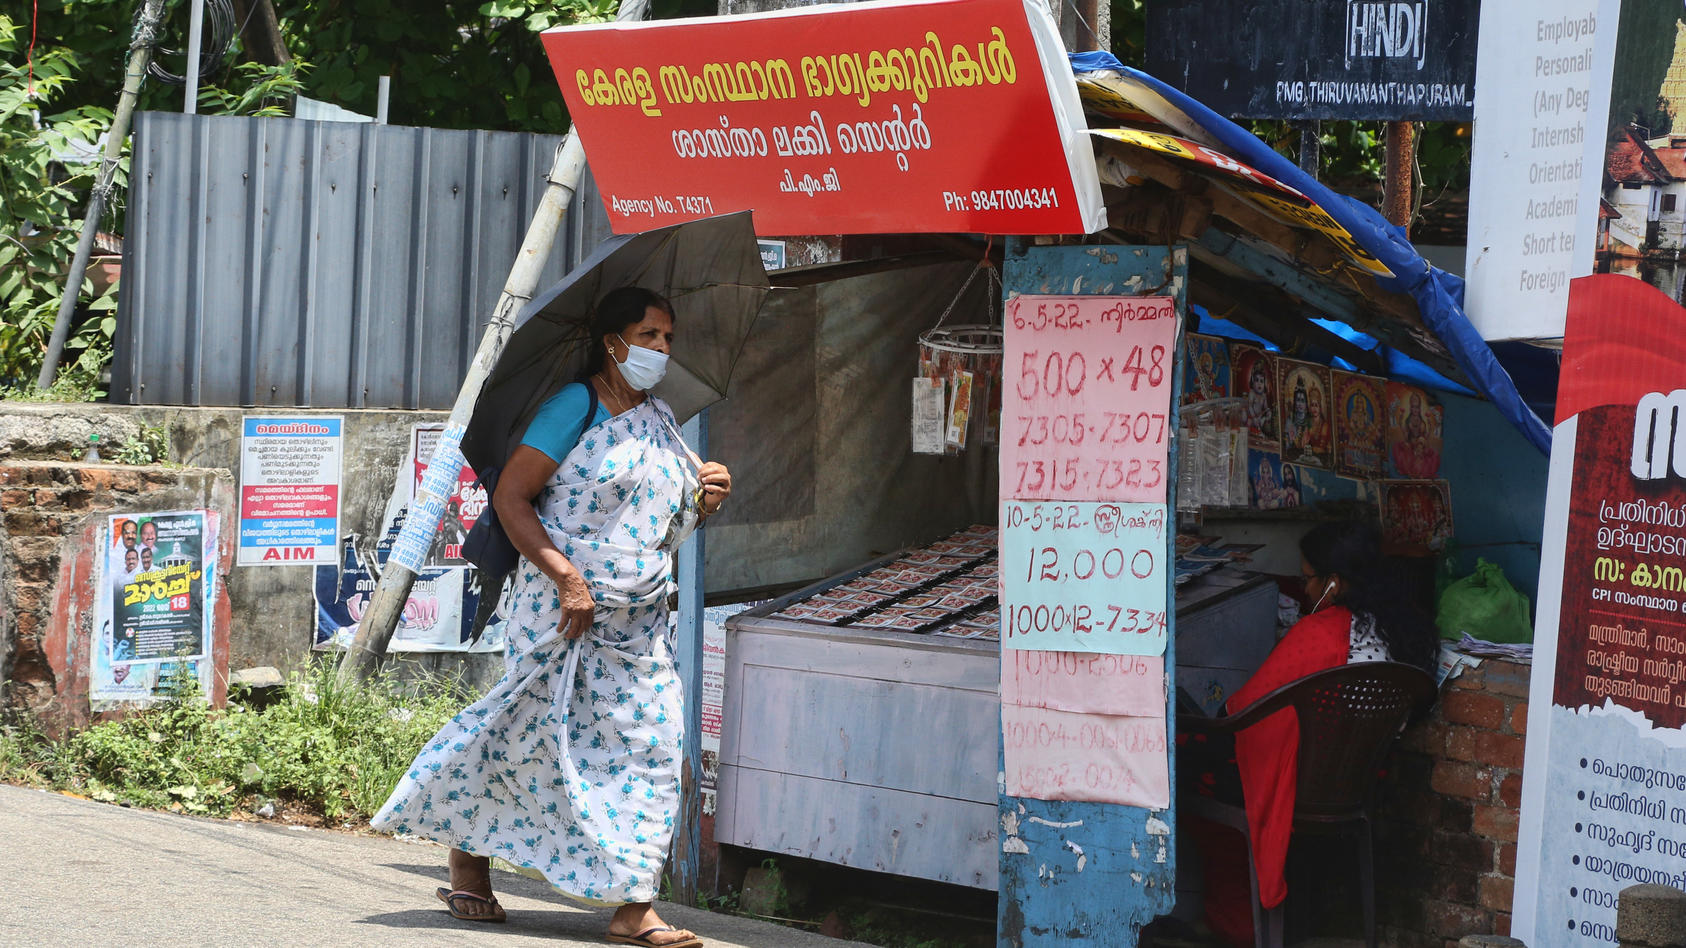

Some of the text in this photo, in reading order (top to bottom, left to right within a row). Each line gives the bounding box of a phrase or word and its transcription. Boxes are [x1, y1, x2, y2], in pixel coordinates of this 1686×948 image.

[1350, 2, 1422, 57] HINDI
[1537, 12, 1596, 45] Employab
[576, 26, 1017, 117] കേരള സംസ്ഥാന ഭാഗ്യക്കുറികൾ
[1536, 48, 1592, 77] Personali
[1534, 87, 1589, 119] (Any Deg
[671, 103, 932, 172] ശാസ്താ ലക്കി സെന്റർ
[1531, 121, 1584, 149] Internsh
[779, 168, 842, 198] പി.എം.ജി
[1529, 156, 1583, 184] Orientati
[612, 194, 714, 217] Agency No. T4371
[942, 187, 1059, 211] Ph: 9847004341
[1526, 193, 1578, 220] Academi
[1523, 232, 1556, 256] Short
[1520, 266, 1566, 293] Foreign
[1016, 350, 1087, 401] 500
[1121, 345, 1166, 391] 48
[1600, 498, 1686, 528] പ്രതിനിധ
[263, 547, 314, 560] AIM
[1027, 547, 1154, 584] 12,000
[171, 597, 187, 609] 18
[1592, 588, 1611, 602] CPI
[1615, 591, 1678, 612] സംസ്ഥാന
[1587, 650, 1639, 675] രാഷ്ട്രീയ
[1585, 675, 1671, 705] തുടങ്ങിയവർ
[1590, 790, 1666, 821] പ്രതിനിധി
